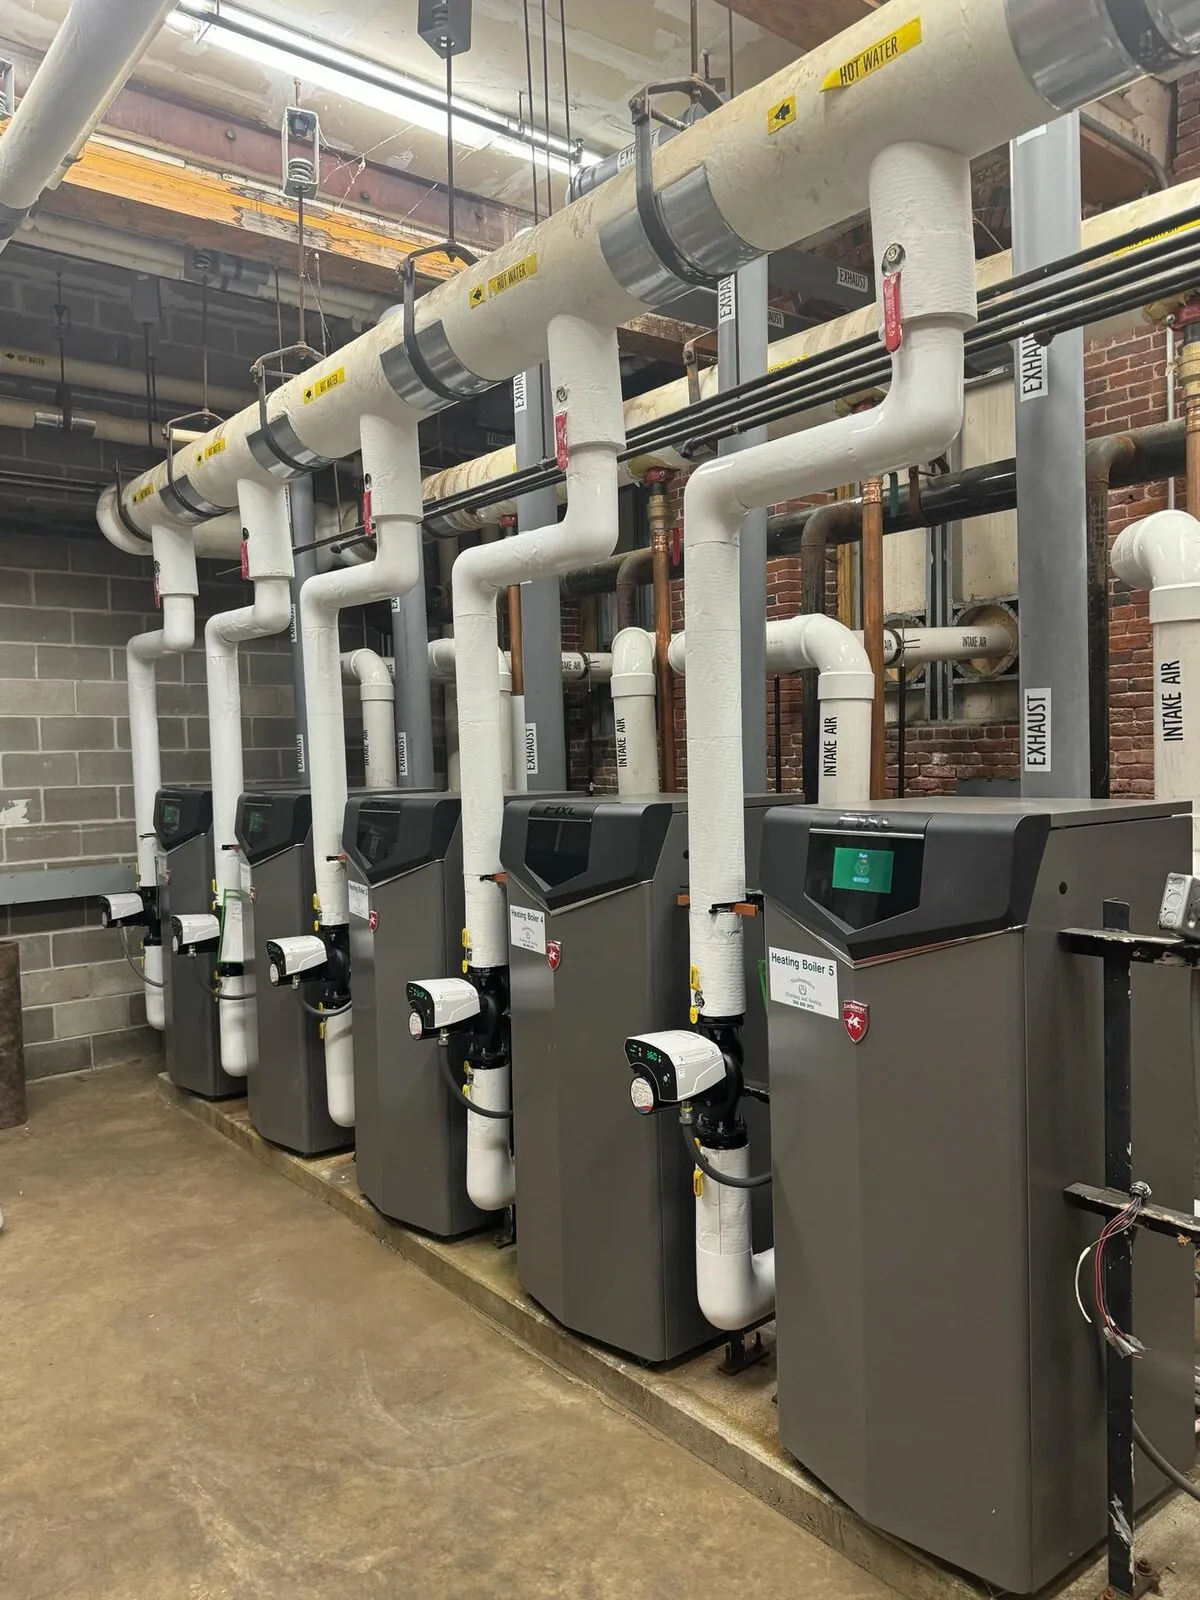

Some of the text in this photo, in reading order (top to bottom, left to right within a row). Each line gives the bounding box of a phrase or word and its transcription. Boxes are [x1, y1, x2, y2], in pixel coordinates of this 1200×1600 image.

[840, 36, 898, 85] HOT WATER
[497, 263, 526, 291] HOT WATER
[719, 276, 732, 319] EXHAU
[839, 269, 866, 288] EXHAUST
[768, 309, 782, 325] AUST
[1022, 336, 1042, 394] EXHAU
[1160, 660, 1183, 741] INTAKE AIR
[525, 727, 536, 770] EXHAUST
[616, 718, 627, 767] INTAKE AIR
[823, 716, 838, 776] INTAKE AIR
[1026, 694, 1046, 766] EXHAUST
[771, 952, 835, 977] Heating Boiler 5
